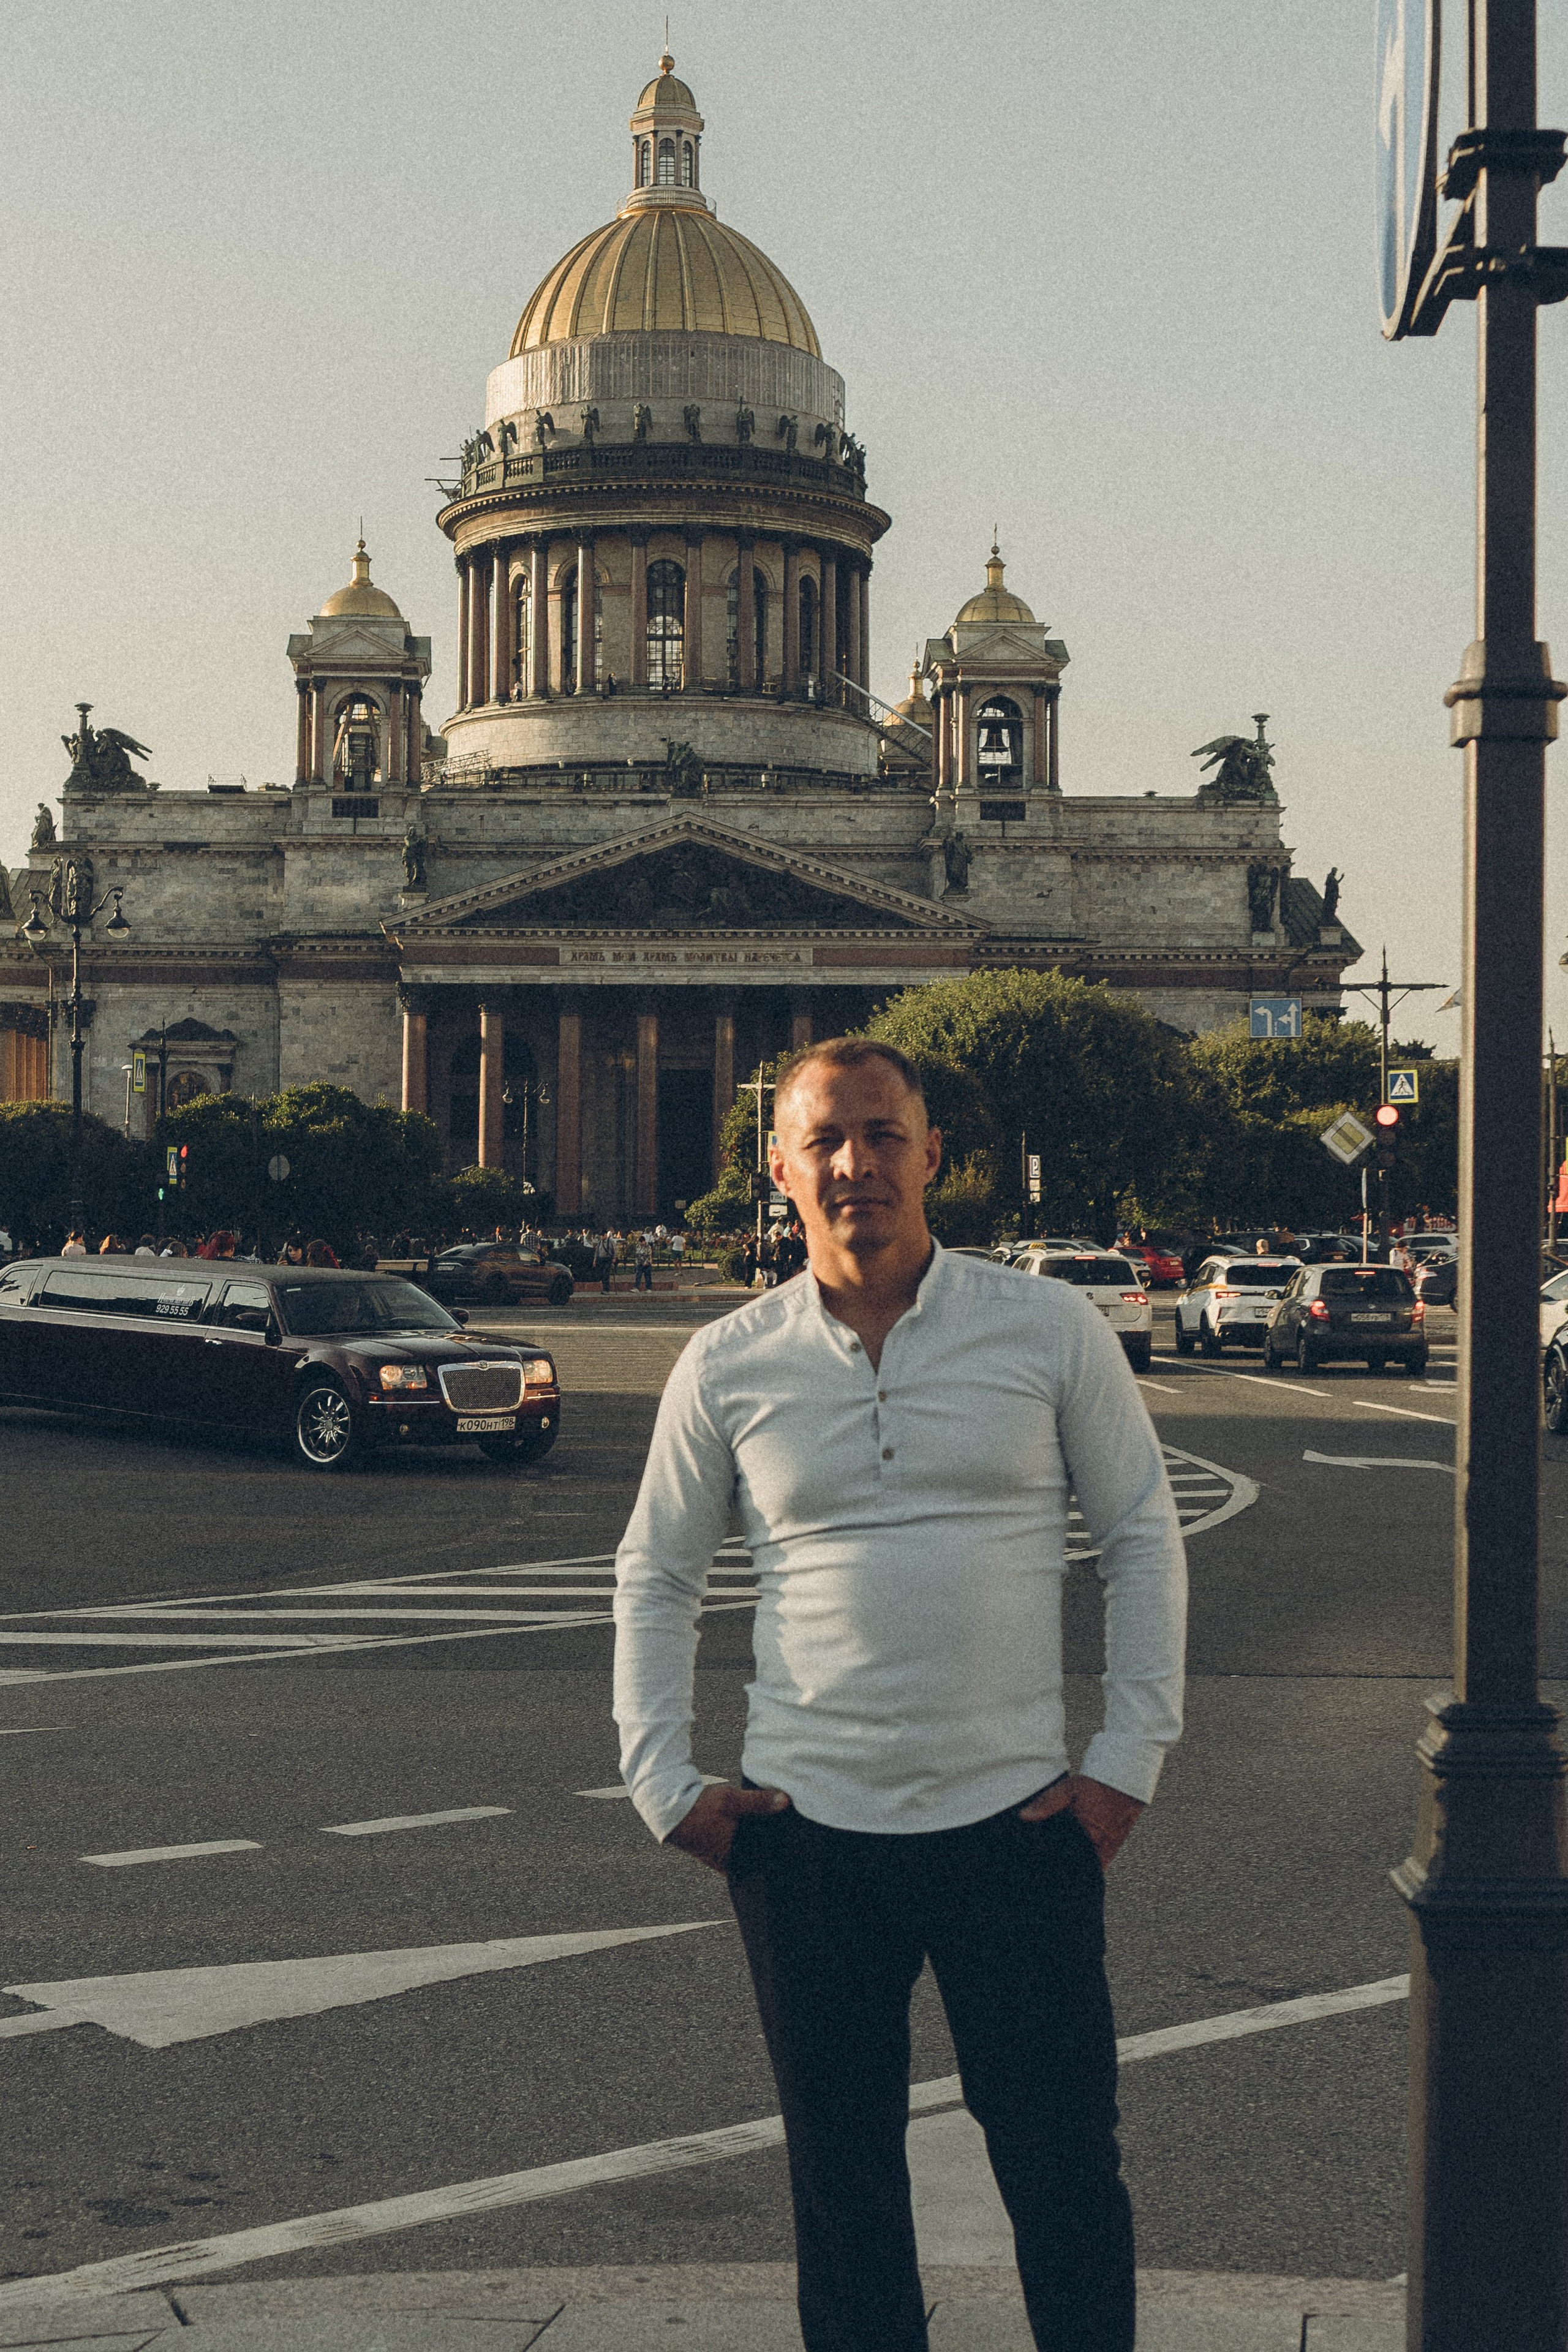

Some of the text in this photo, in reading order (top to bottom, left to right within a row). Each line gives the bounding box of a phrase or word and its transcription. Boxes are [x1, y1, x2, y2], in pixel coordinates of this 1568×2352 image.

[156, 1305, 189, 1316] 929 55 55
[500, 1417, 514, 1427] 198
